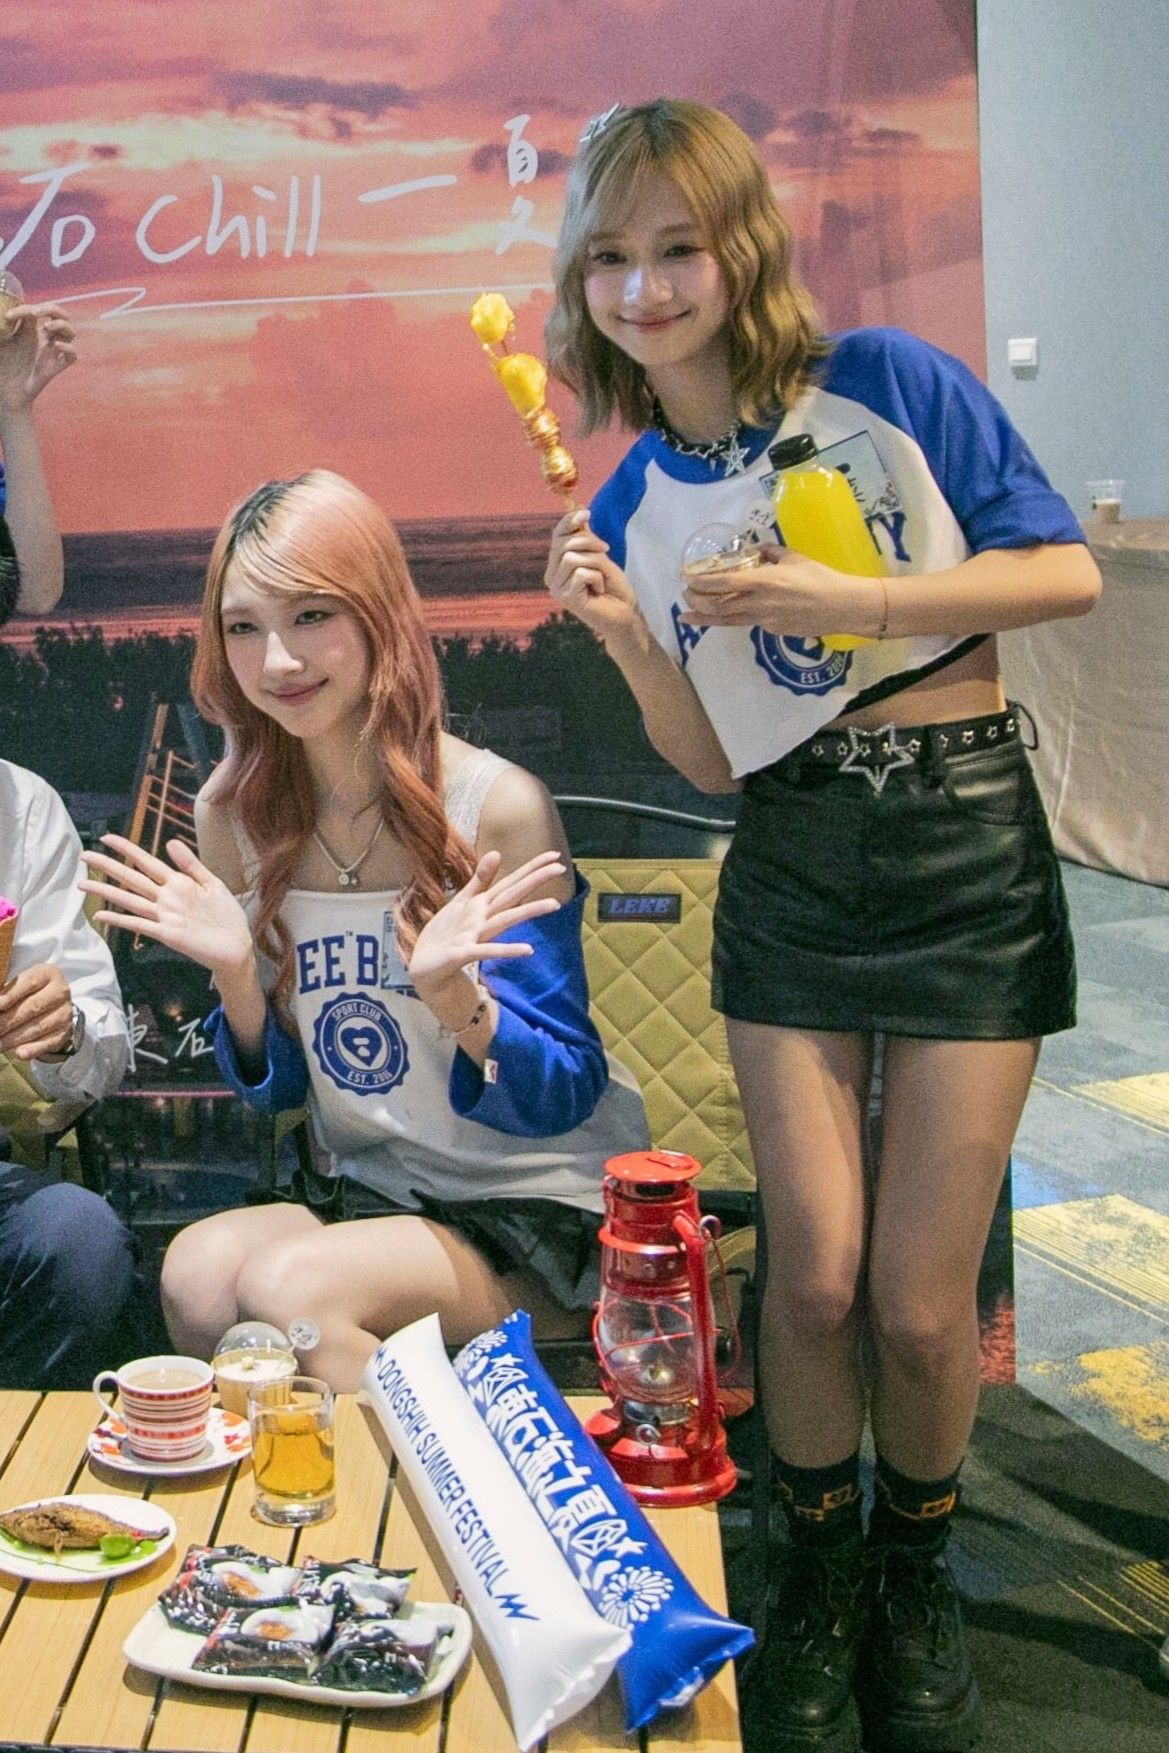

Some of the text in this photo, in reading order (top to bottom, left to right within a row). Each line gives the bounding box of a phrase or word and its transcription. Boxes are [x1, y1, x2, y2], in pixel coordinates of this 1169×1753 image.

[333, 1002, 382, 1020] SPORT CLUB
[377, 1358, 510, 1598] DONGSHIH SUMMER FESTIVAL
